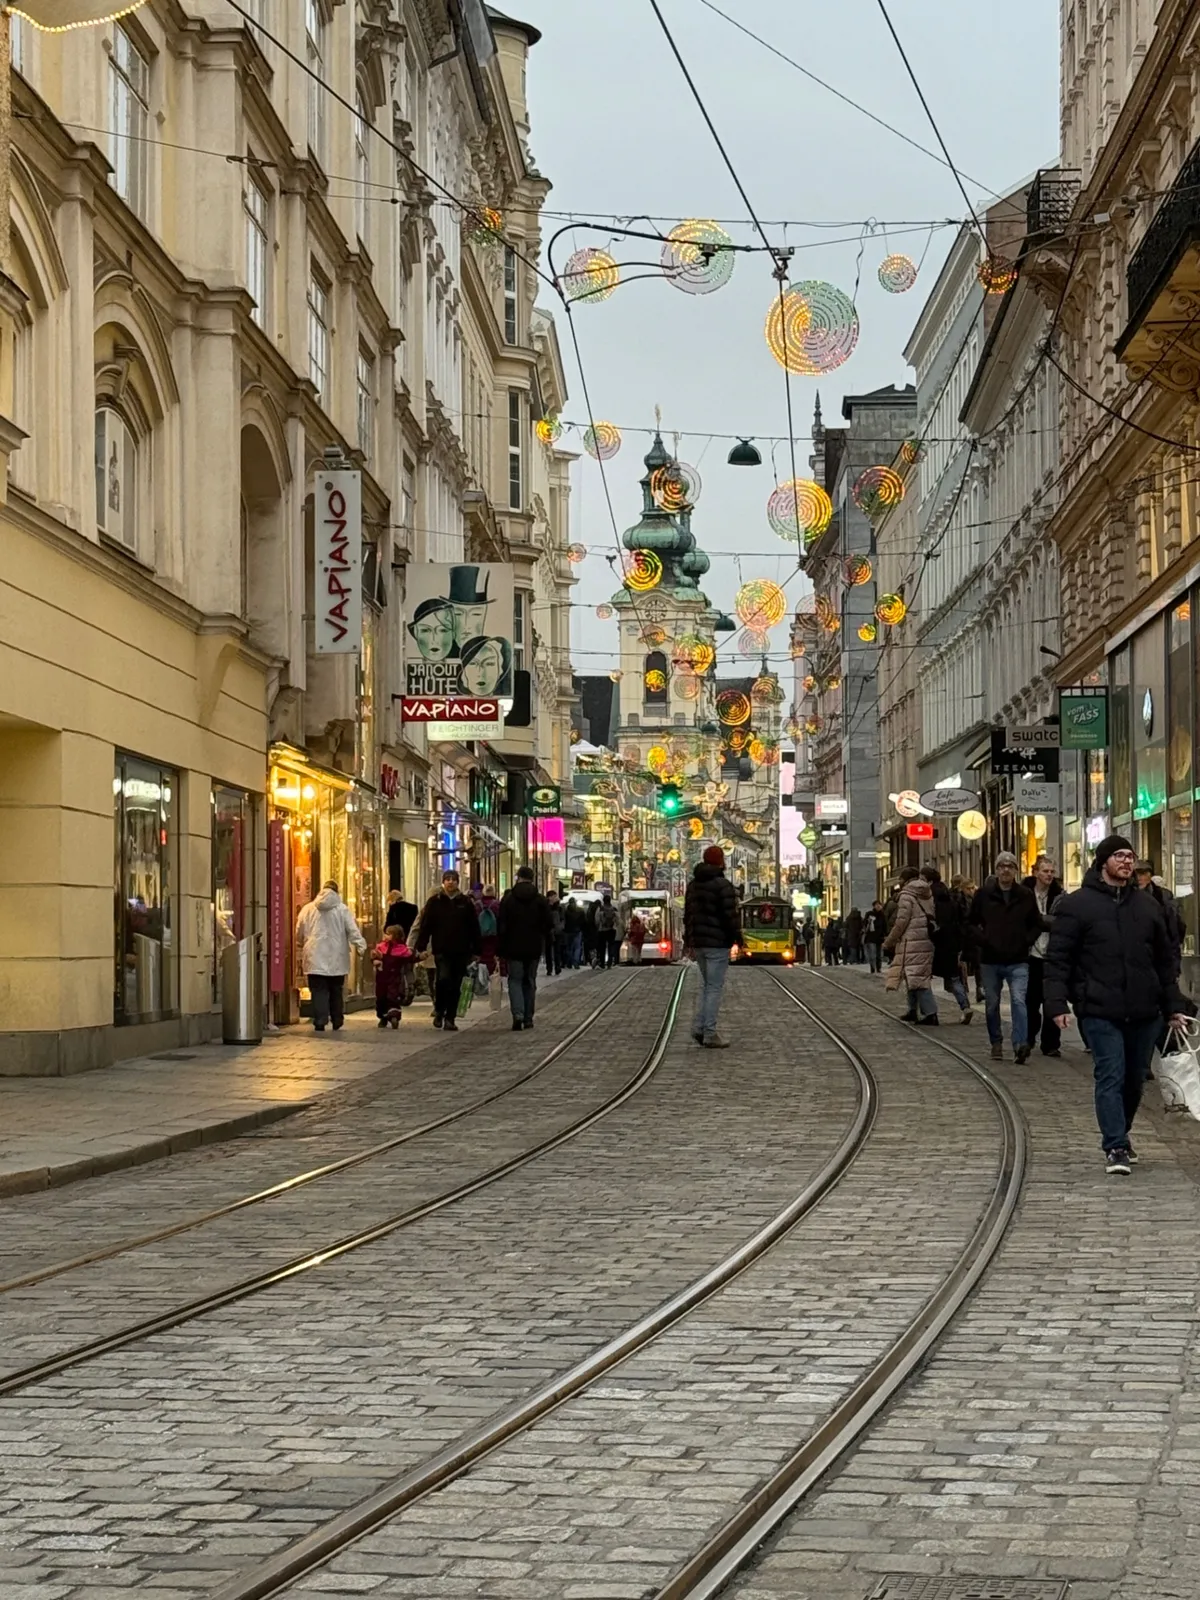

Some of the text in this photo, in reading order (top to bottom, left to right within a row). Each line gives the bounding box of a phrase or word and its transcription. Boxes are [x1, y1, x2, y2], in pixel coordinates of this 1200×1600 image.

[409, 663, 458, 676] JANOUT
[409, 674, 457, 695] HÜTE
[1073, 708, 1099, 723] FASS
[1012, 729, 1058, 741] swatc
